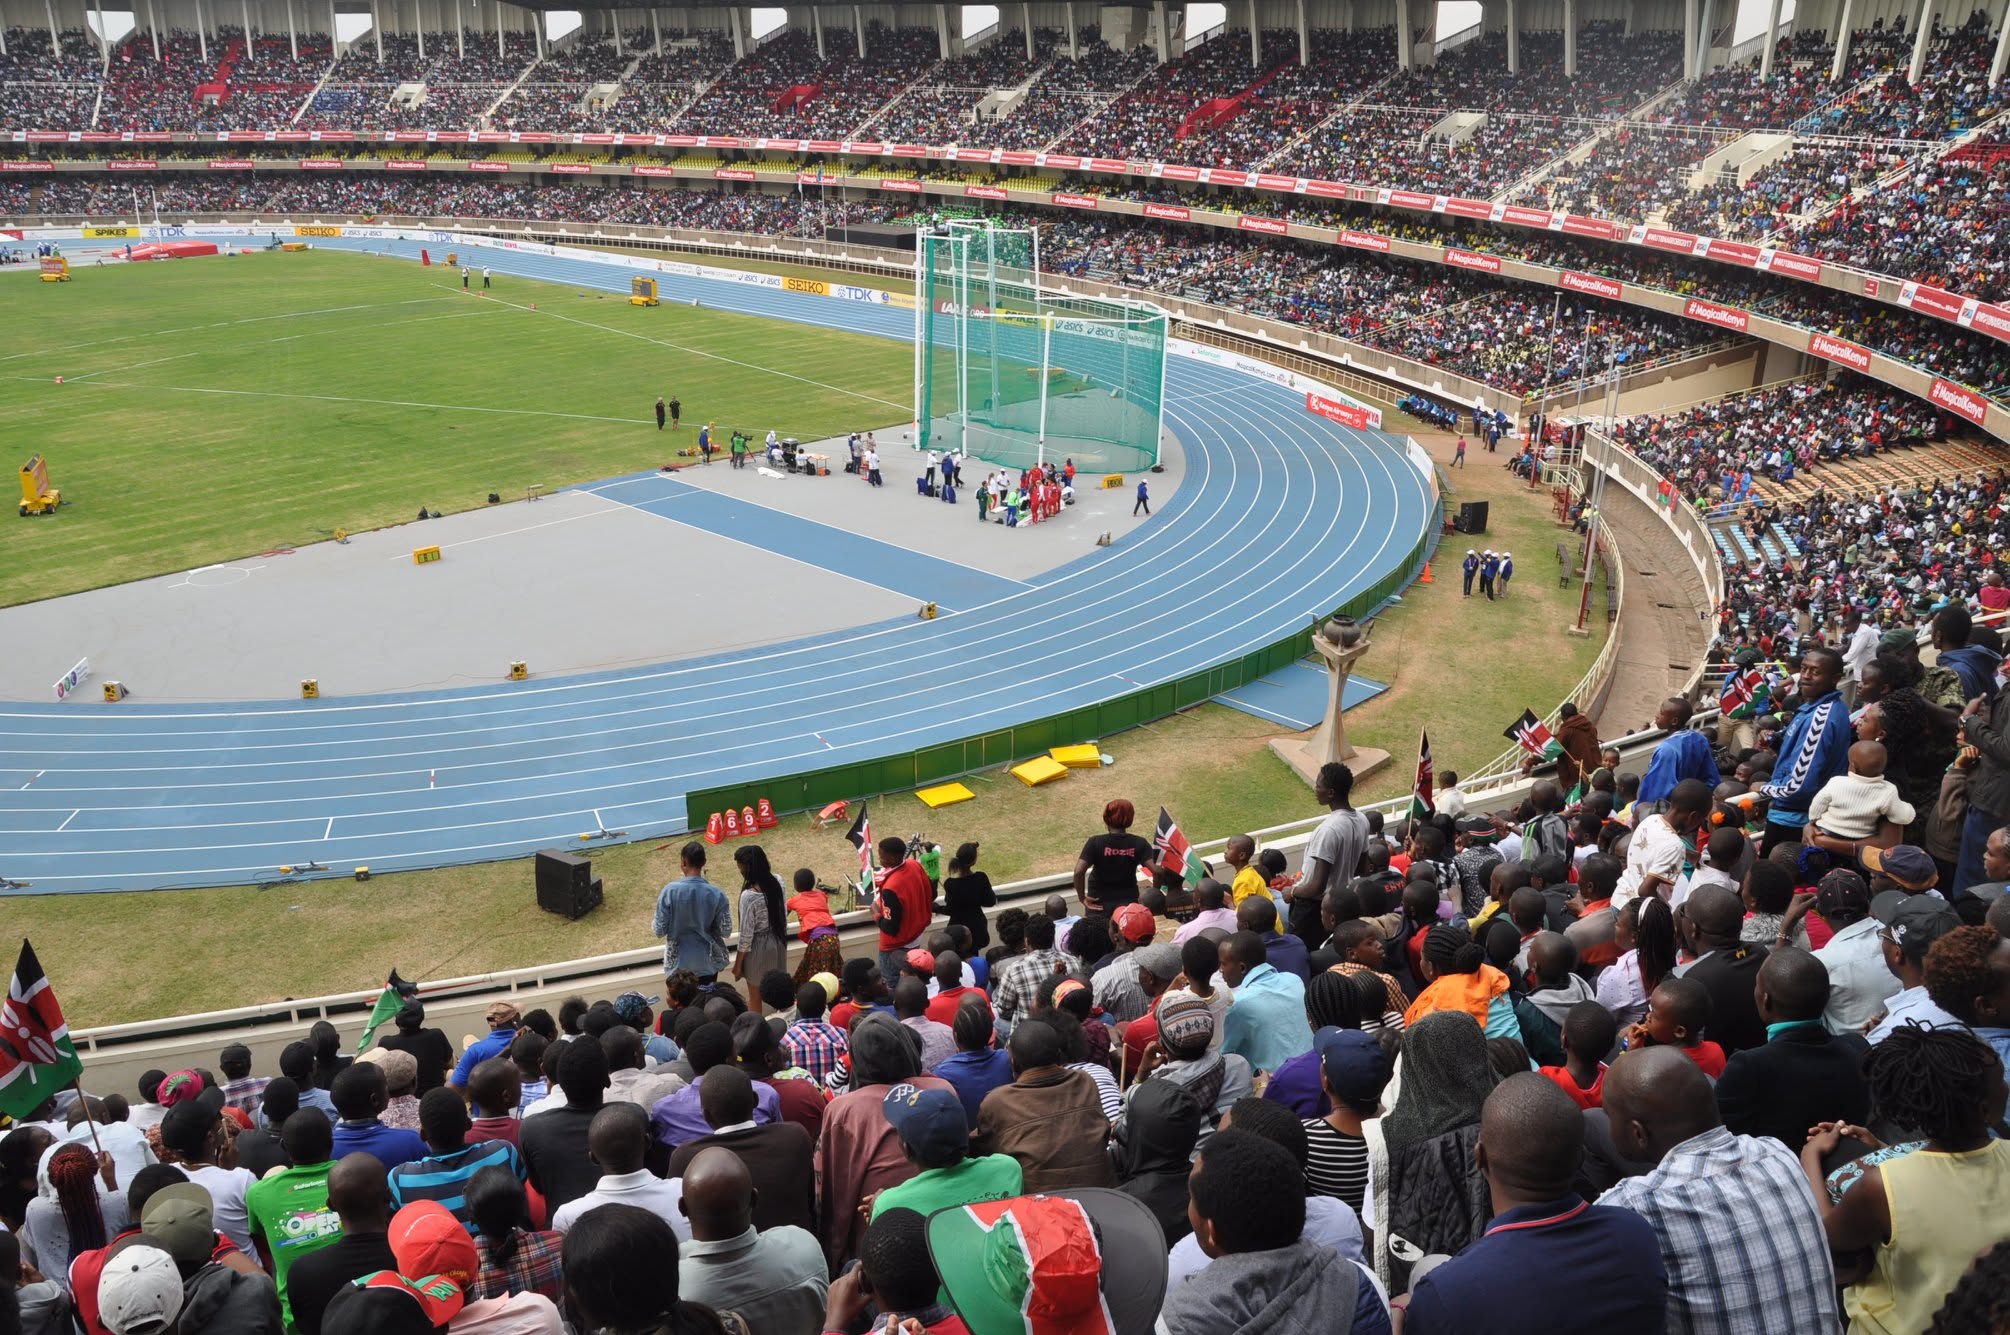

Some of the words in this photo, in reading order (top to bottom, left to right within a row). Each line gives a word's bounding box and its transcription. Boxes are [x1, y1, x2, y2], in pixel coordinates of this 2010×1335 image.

[1055, 194, 1096, 207] #MagicalKenya
[1146, 205, 1189, 219] #MagicalKenya
[160, 227, 186, 237] TDK
[301, 227, 335, 237] SEIKO
[1241, 217, 1285, 233] #MagicalKenya
[95, 228, 127, 237] SPIKES
[434, 232, 454, 242] TDK
[1341, 231, 1388, 250] #MagicalKenya
[1448, 249, 1498, 270] #MagicalKenya
[788, 279, 824, 294] SEIKO
[1563, 275, 1618, 296] #MagicalKenya
[846, 286, 873, 302] TDK
[1688, 301, 1746, 328] #MagicalKenya
[1064, 320, 1084, 333] asics
[1095, 328, 1114, 339] asics
[1812, 338, 1868, 367] #MagicalKenya
[1932, 381, 1984, 420] #MagicalKenya
[761, 804, 769, 816] 2
[711, 822, 716, 832] 1
[727, 818, 736, 829] 6
[745, 814, 754, 826] 9
